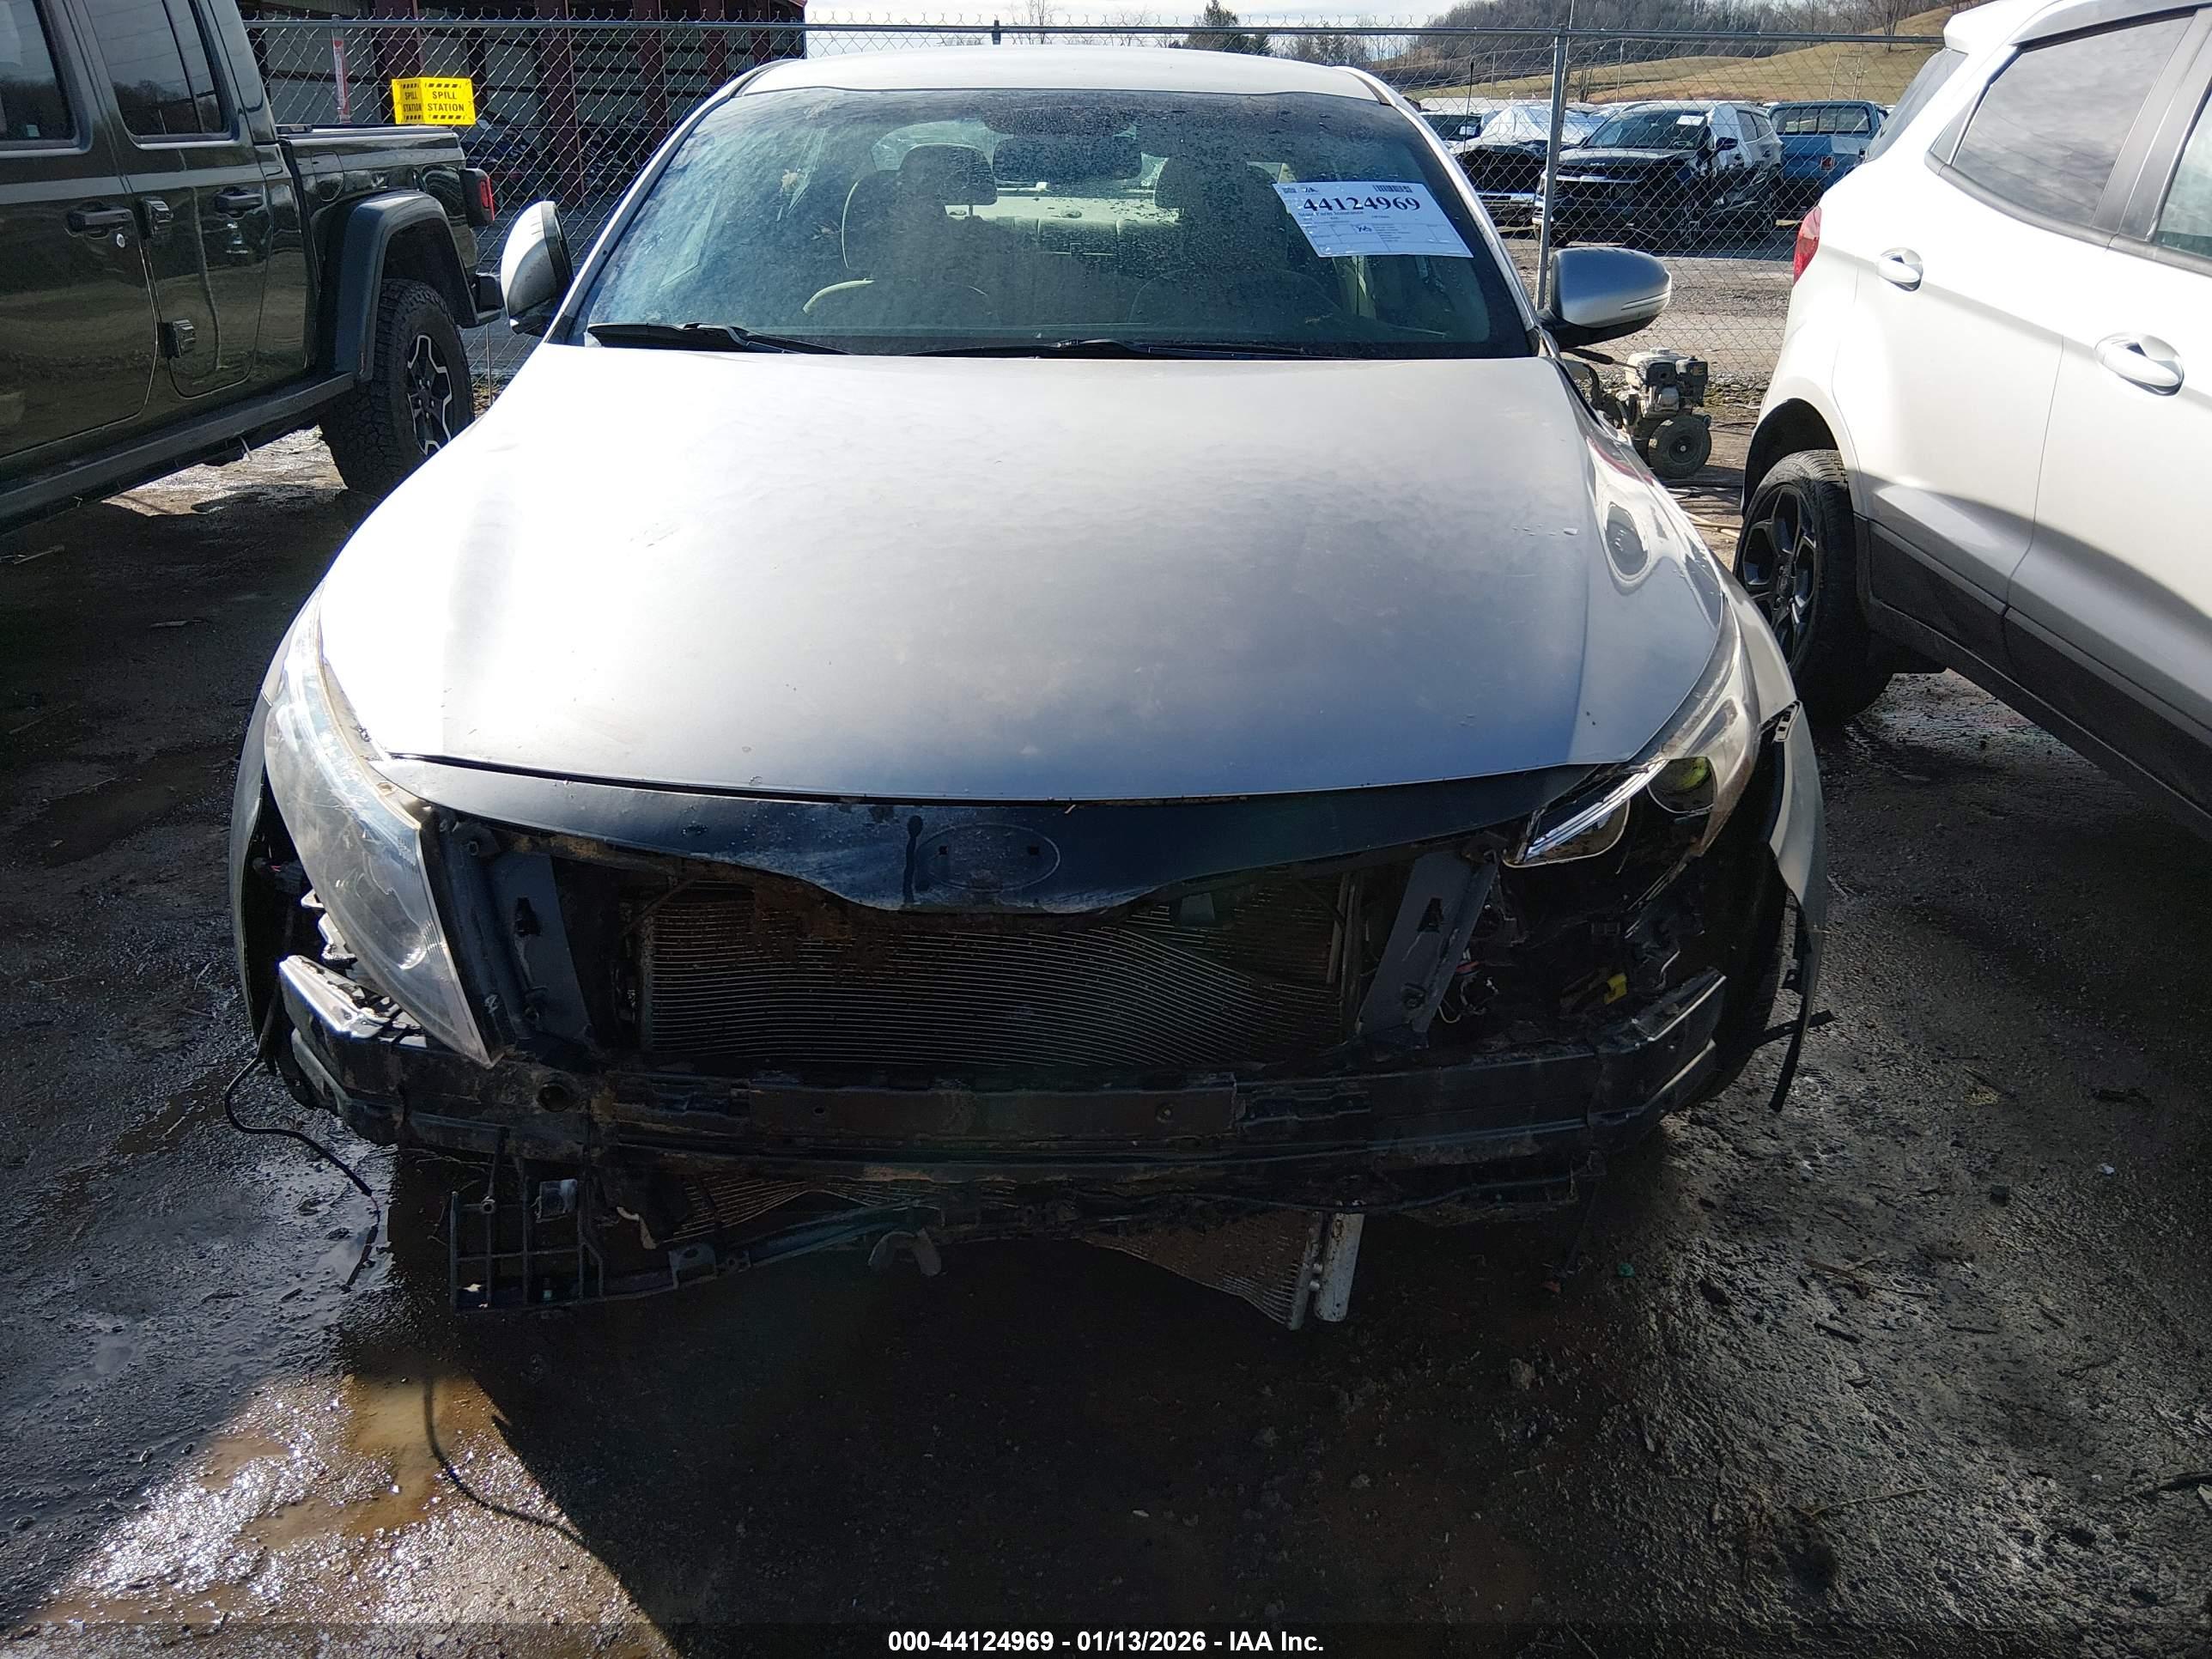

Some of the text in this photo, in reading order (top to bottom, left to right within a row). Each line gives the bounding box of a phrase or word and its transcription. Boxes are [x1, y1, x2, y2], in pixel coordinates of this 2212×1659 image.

[404, 91, 418, 100] SPILL
[432, 91, 457, 100] SPILL
[403, 103, 422, 112] STATION
[428, 103, 465, 112] STATION
[1303, 196, 1421, 211] 44124969
